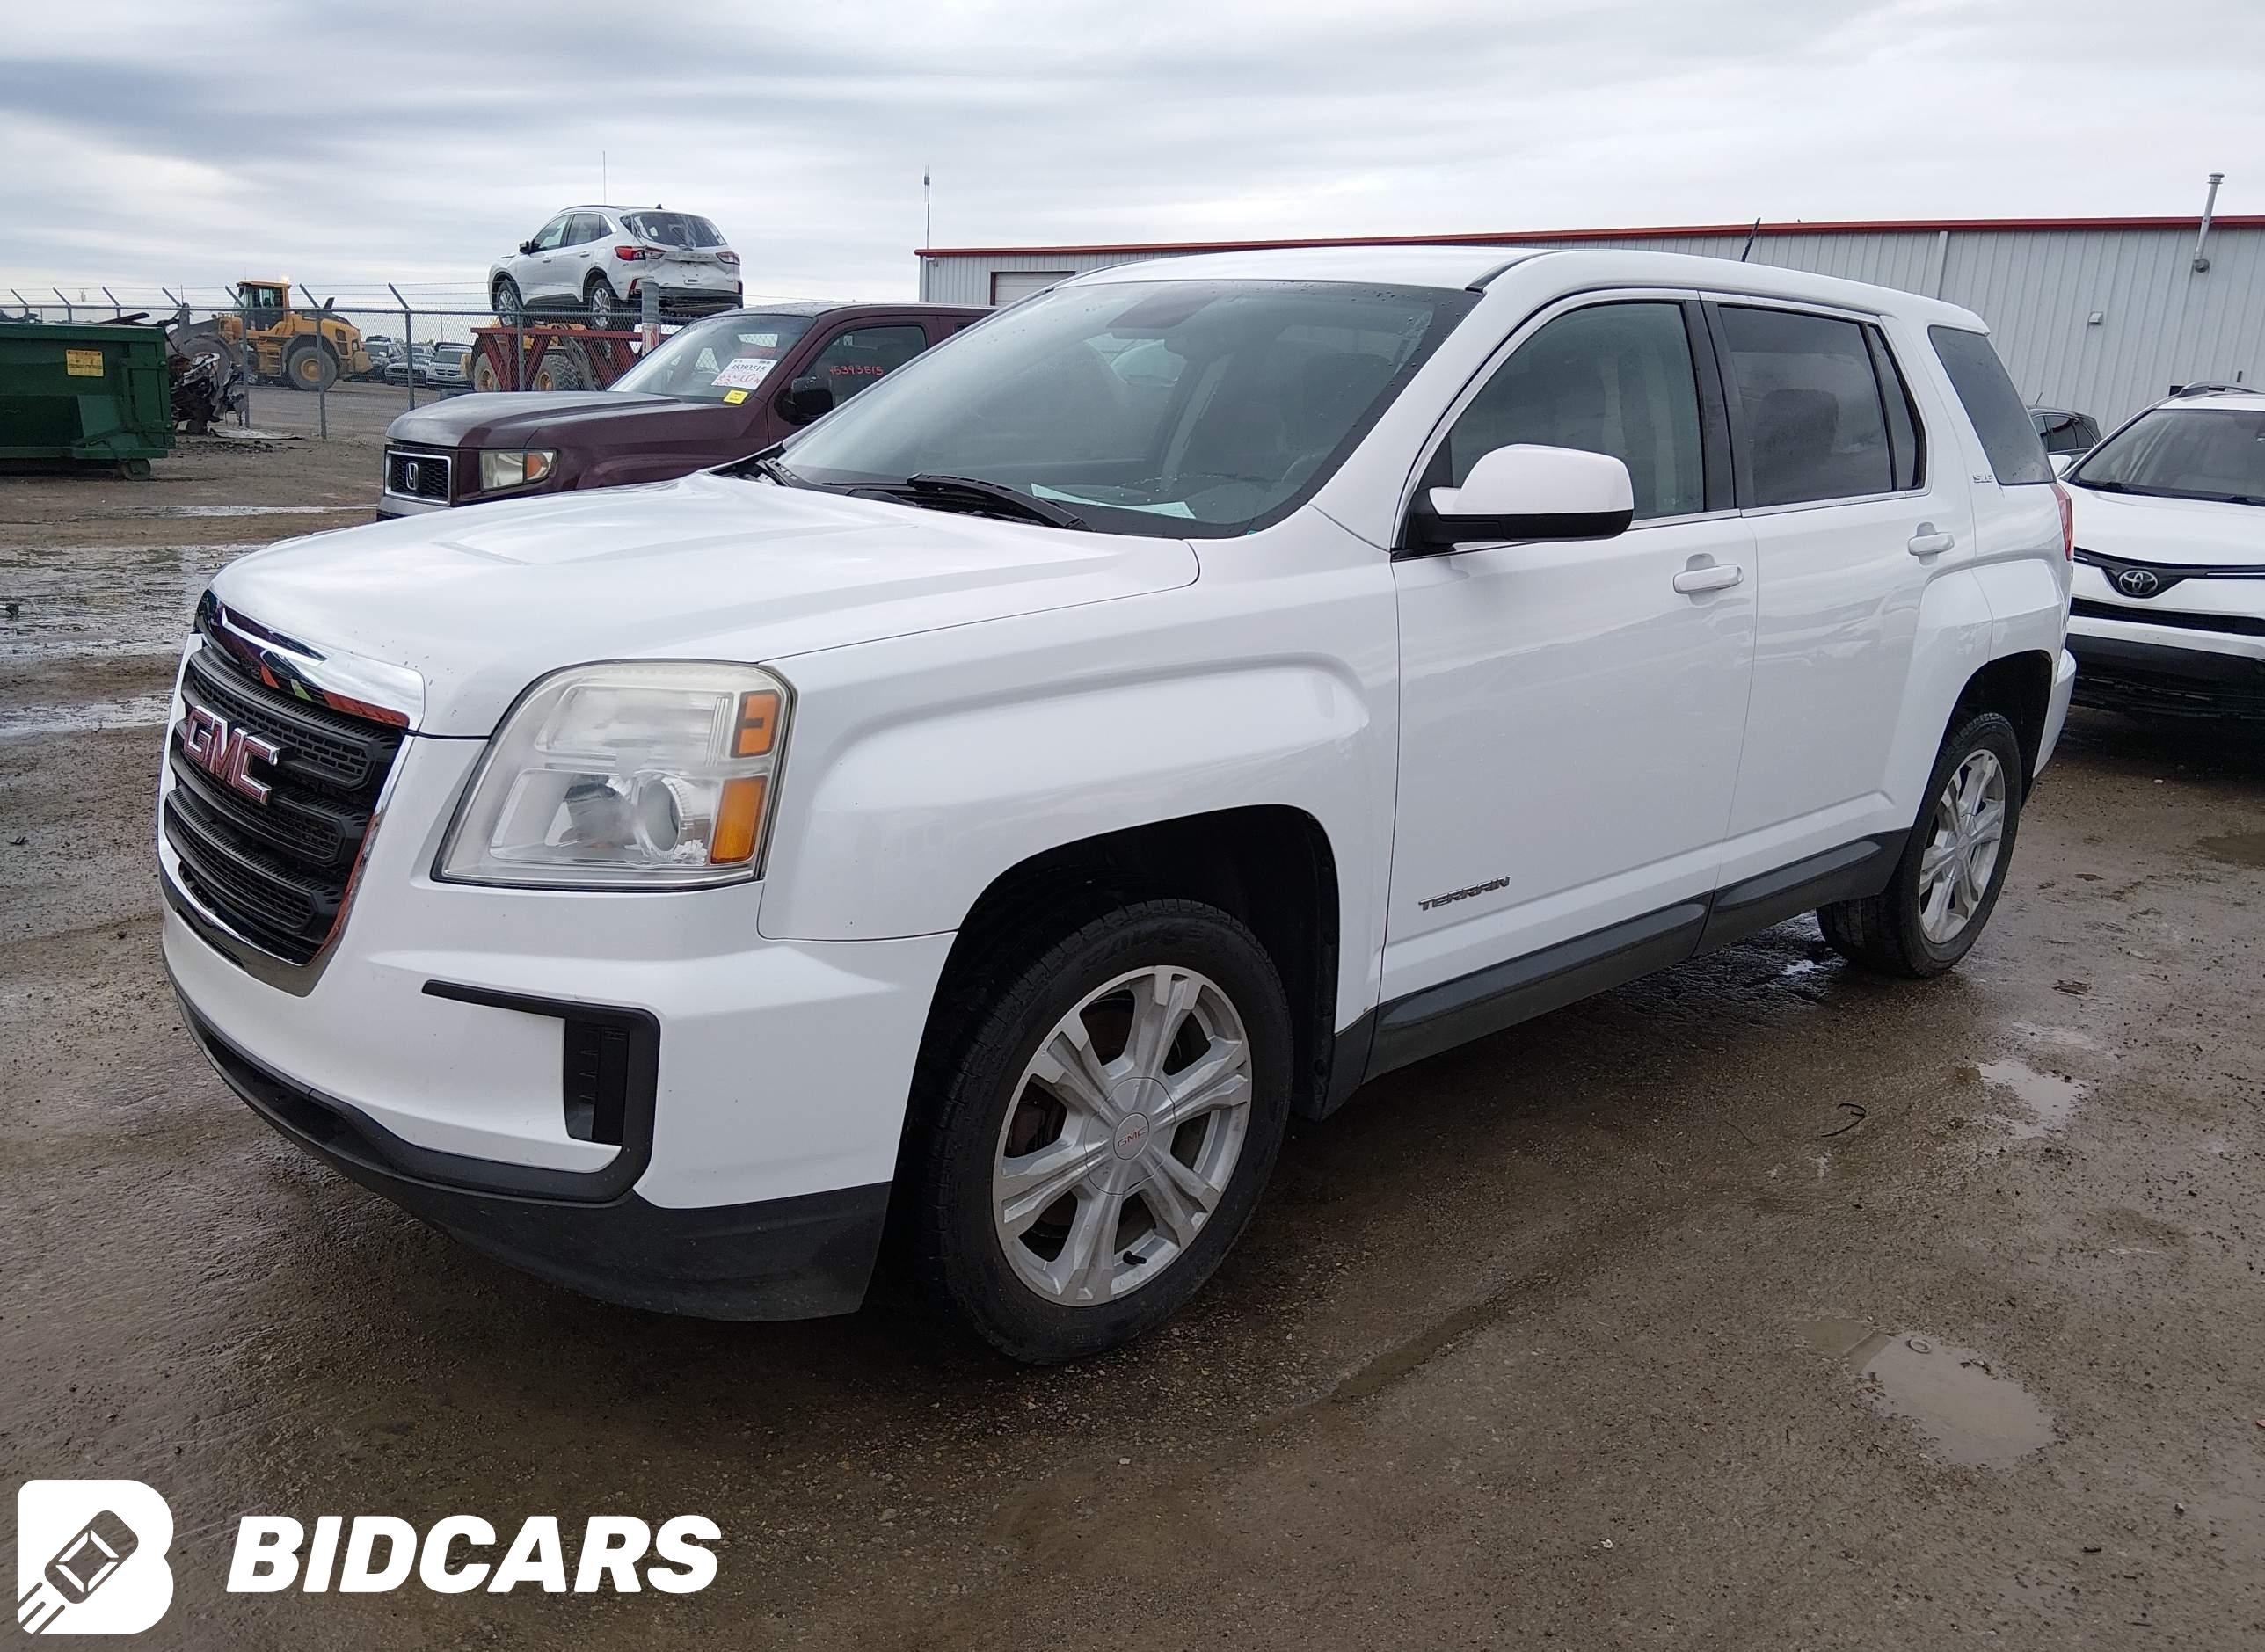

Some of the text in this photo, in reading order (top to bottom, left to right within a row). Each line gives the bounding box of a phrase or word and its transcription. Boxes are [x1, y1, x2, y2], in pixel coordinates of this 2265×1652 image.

[184, 705, 280, 806] GMC
[1418, 876, 1510, 911] TERRAIN
[1118, 1126, 1147, 1146] GMC
